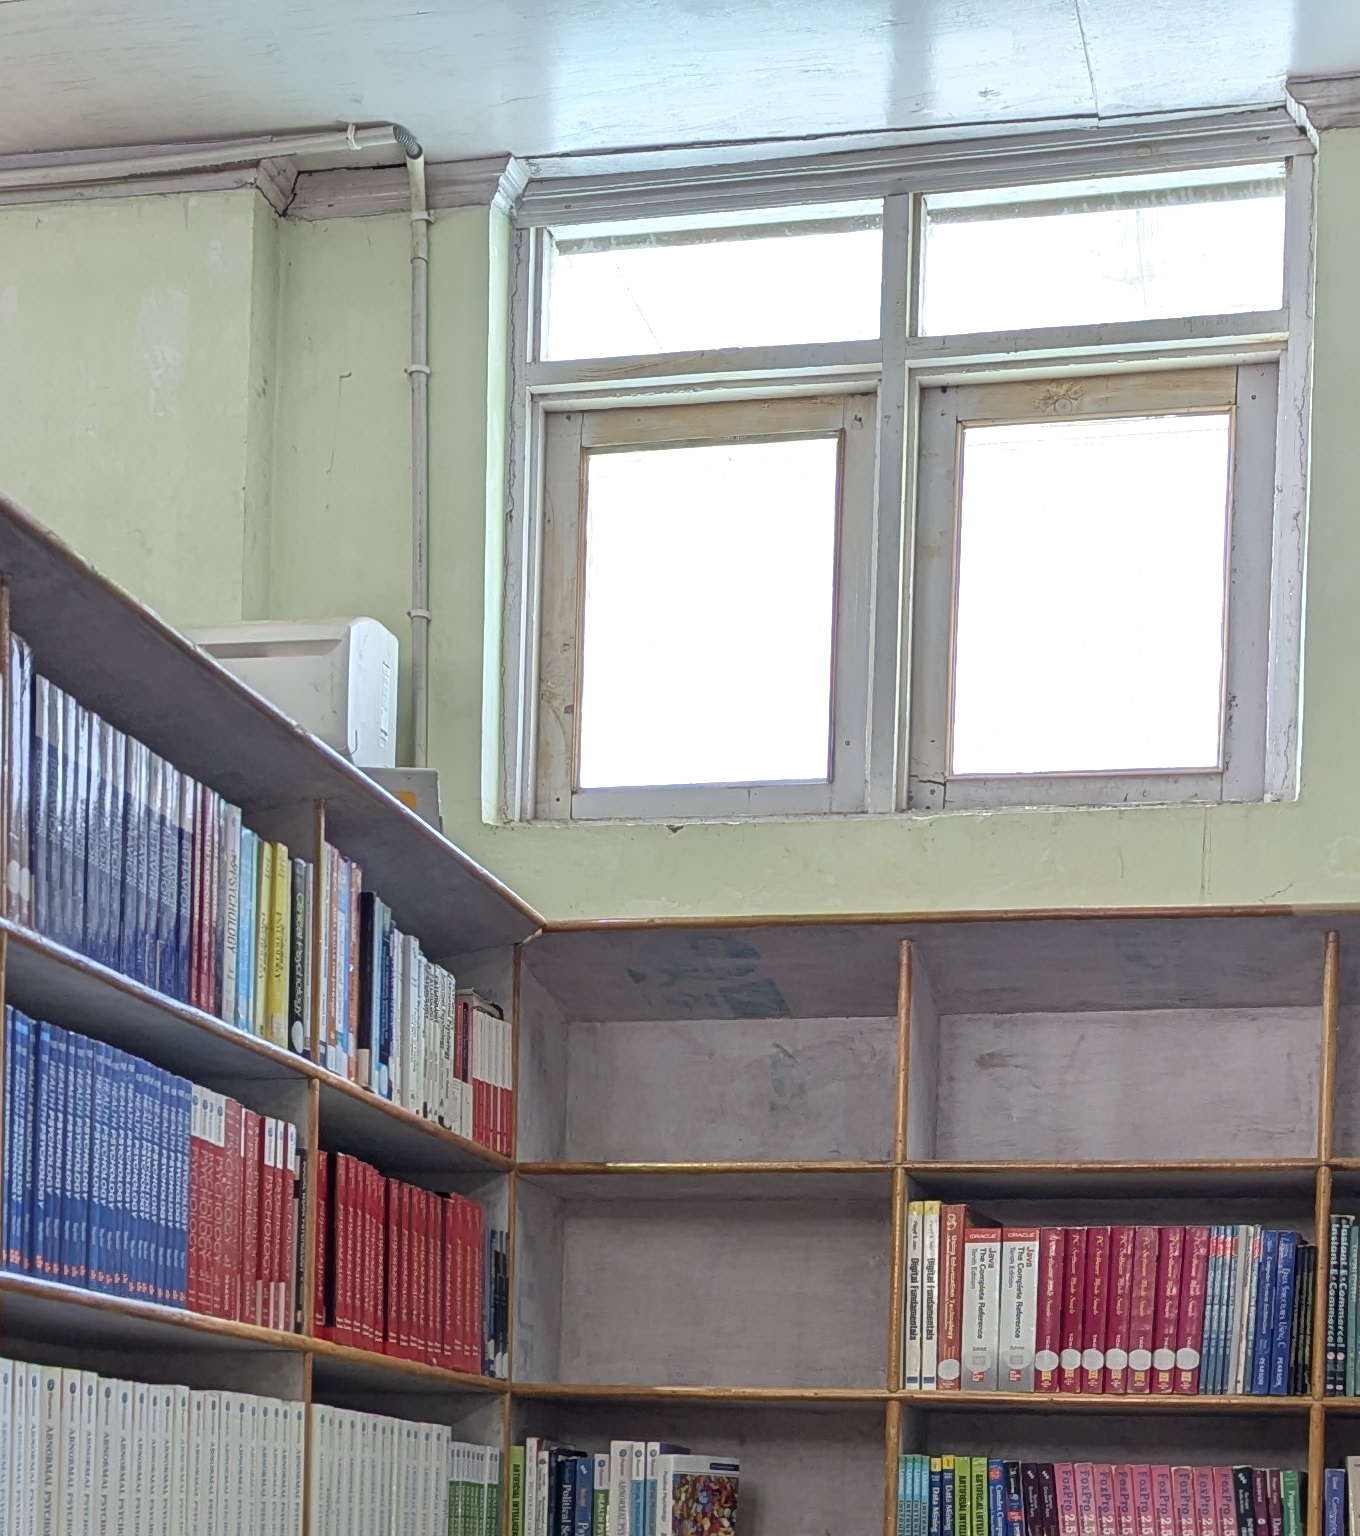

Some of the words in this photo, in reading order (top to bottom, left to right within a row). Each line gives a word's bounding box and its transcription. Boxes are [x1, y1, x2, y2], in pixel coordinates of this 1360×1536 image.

[978, 1248, 986, 1262] The
[987, 1247, 996, 1269] Java
[926, 1257, 936, 1283] Digital
[976, 1264, 986, 1300] Complete
[926, 1285, 935, 1340] Fundamentals
[977, 1302, 985, 1340] Reference
[1274, 1357, 1283, 1387] PEARSON
[561, 1484, 571, 1522] Political
[945, 1485, 953, 1502] Data
[1061, 1470, 1072, 1511] FoxPro
[1157, 1473, 1168, 1514] FoxPro
[1221, 1473, 1231, 1514] FoxPro
[944, 1504, 953, 1530] Mining
[1064, 1513, 1075, 1533] 2.5
[1160, 1517, 1171, 1536] 2.5
[1223, 1517, 1235, 1536] 2.5
